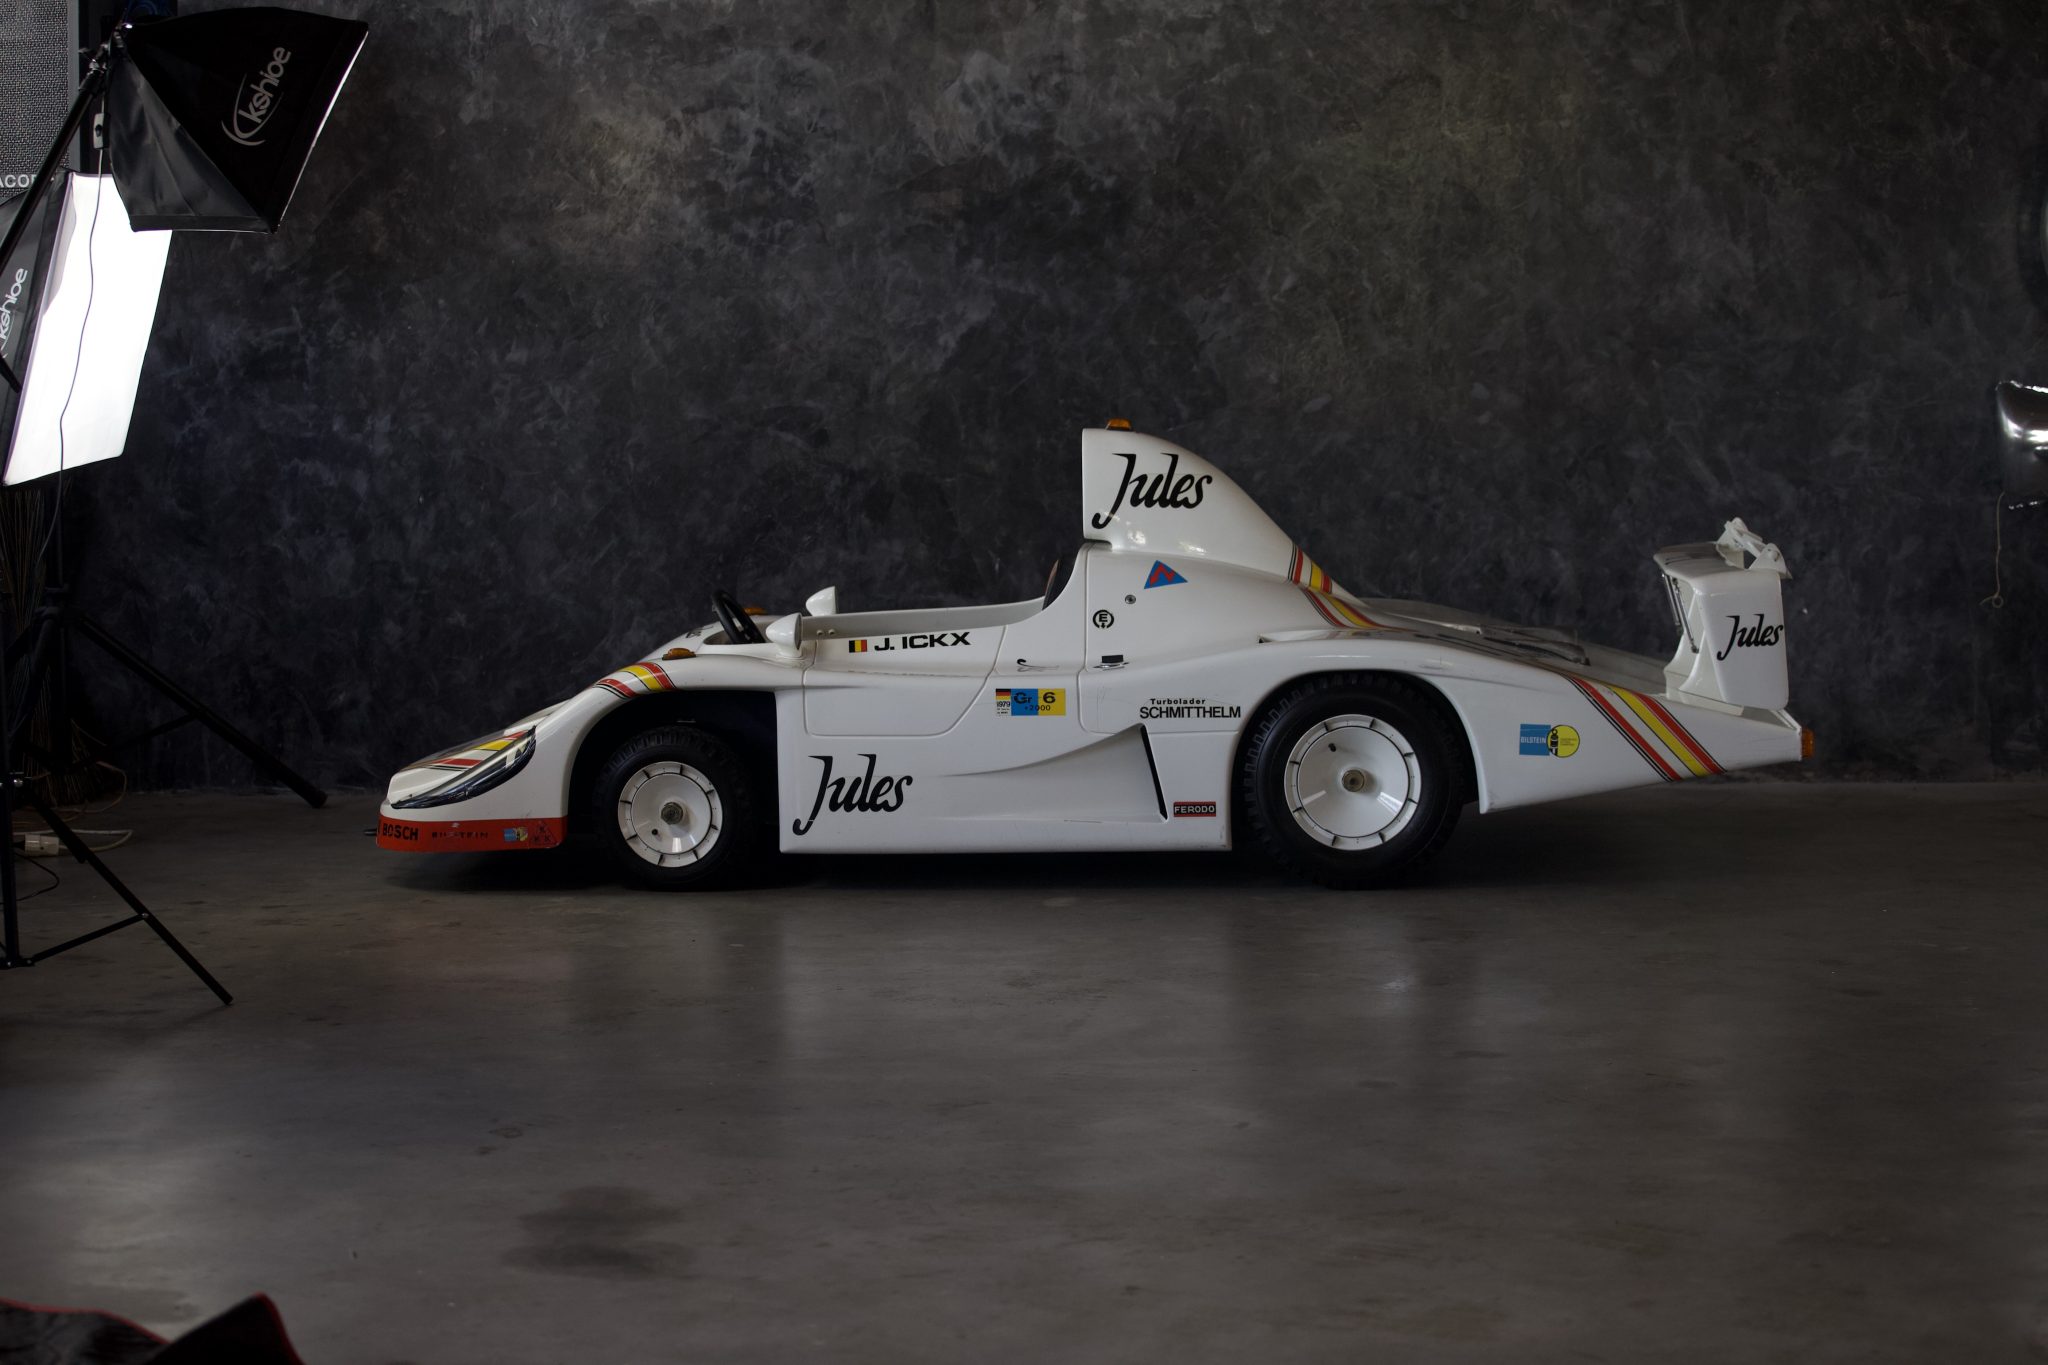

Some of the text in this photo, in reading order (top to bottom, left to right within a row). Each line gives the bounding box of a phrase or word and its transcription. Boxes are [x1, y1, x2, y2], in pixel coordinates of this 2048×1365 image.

[237, 46, 292, 124] kshioe
[1091, 453, 1213, 530] Jules
[874, 631, 971, 651] J. ICKX
[1716, 613, 1784, 661] Jules
[1013, 691, 1056, 705] Gr 6
[1139, 706, 1242, 719] SCHMITTHELM
[1520, 736, 1547, 744] BILSTEIN
[792, 753, 914, 836] Jules
[1174, 805, 1215, 814] FERODO
[382, 822, 419, 841] BOSCH
